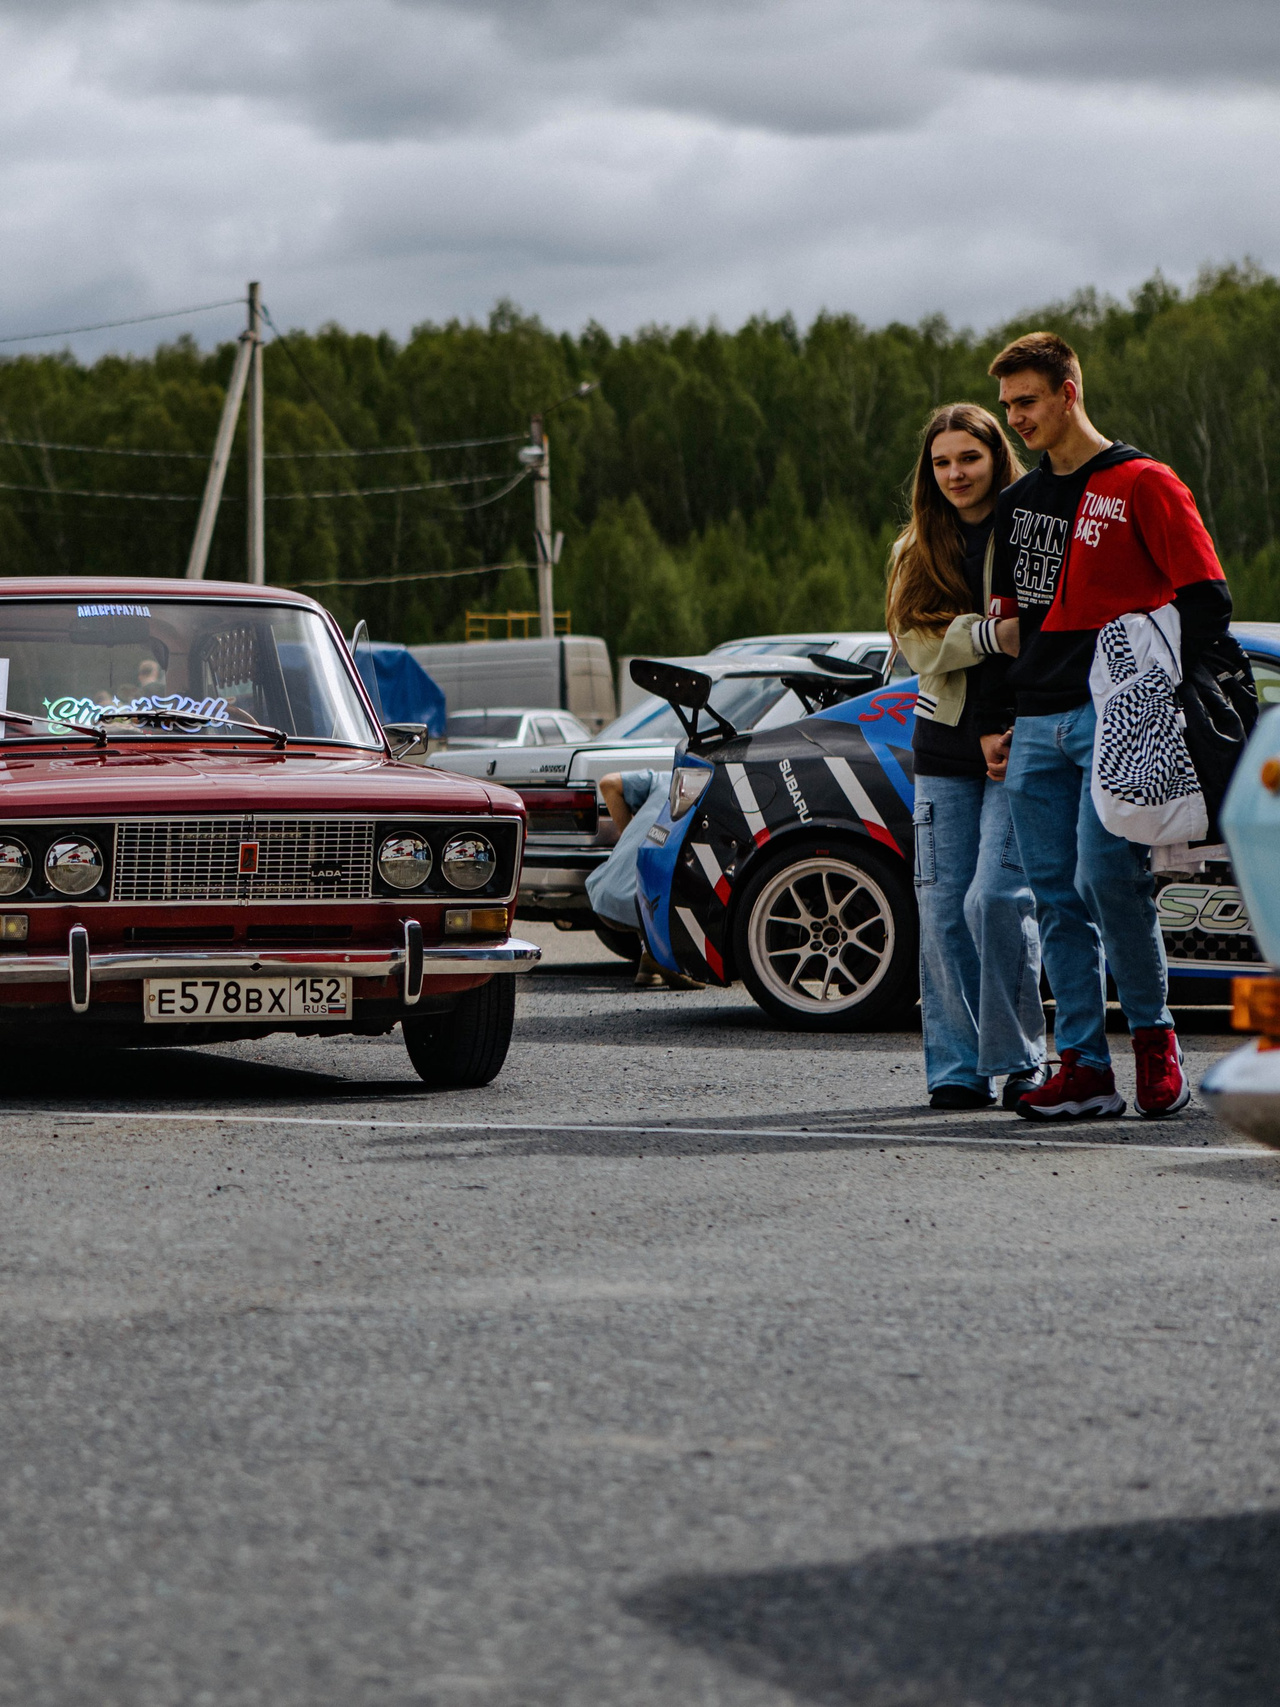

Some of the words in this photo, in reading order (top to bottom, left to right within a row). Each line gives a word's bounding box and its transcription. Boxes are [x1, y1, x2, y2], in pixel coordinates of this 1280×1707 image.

[1082, 491, 1127, 522] TUNNEL
[778, 758, 813, 825] SUBARU
[311, 870, 342, 878] LADA
[294, 978, 341, 1004] 152
[303, 1004, 328, 1014] RUS
